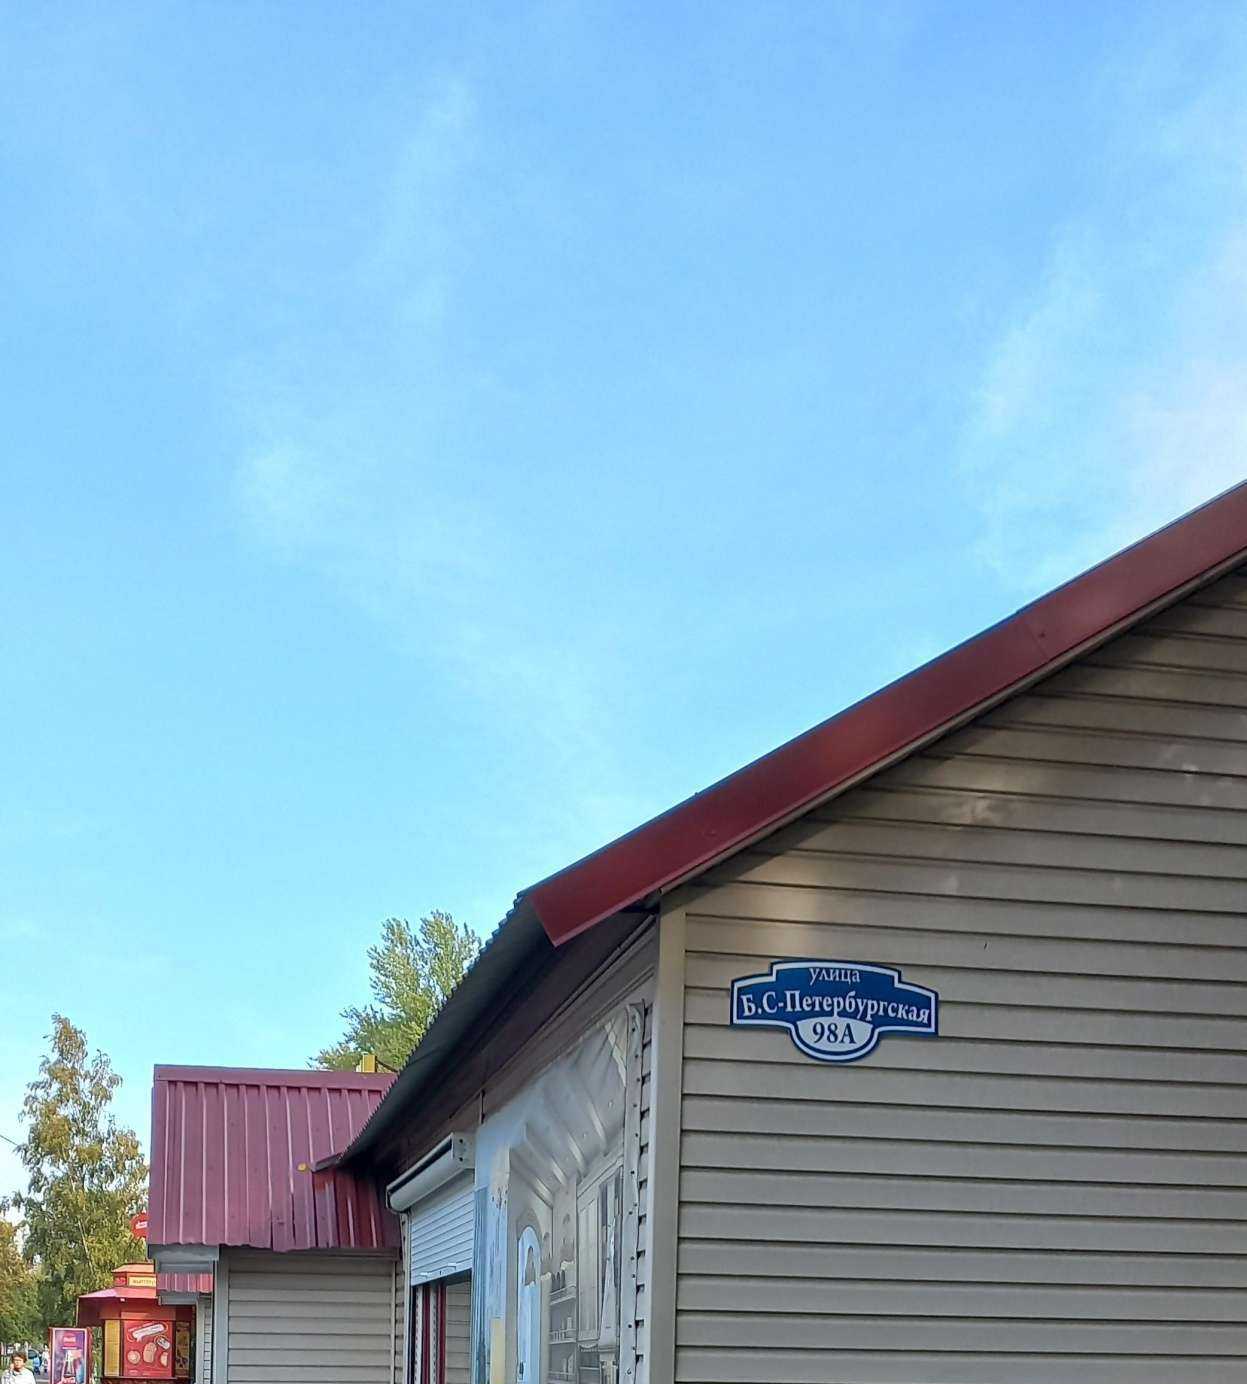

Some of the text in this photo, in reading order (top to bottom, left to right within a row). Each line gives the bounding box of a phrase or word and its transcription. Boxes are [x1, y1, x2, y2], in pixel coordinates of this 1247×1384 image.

[809, 966, 861, 986] улица
[740, 990, 930, 1024] Б.С-Петербургская
[811, 1021, 857, 1045] 98А
